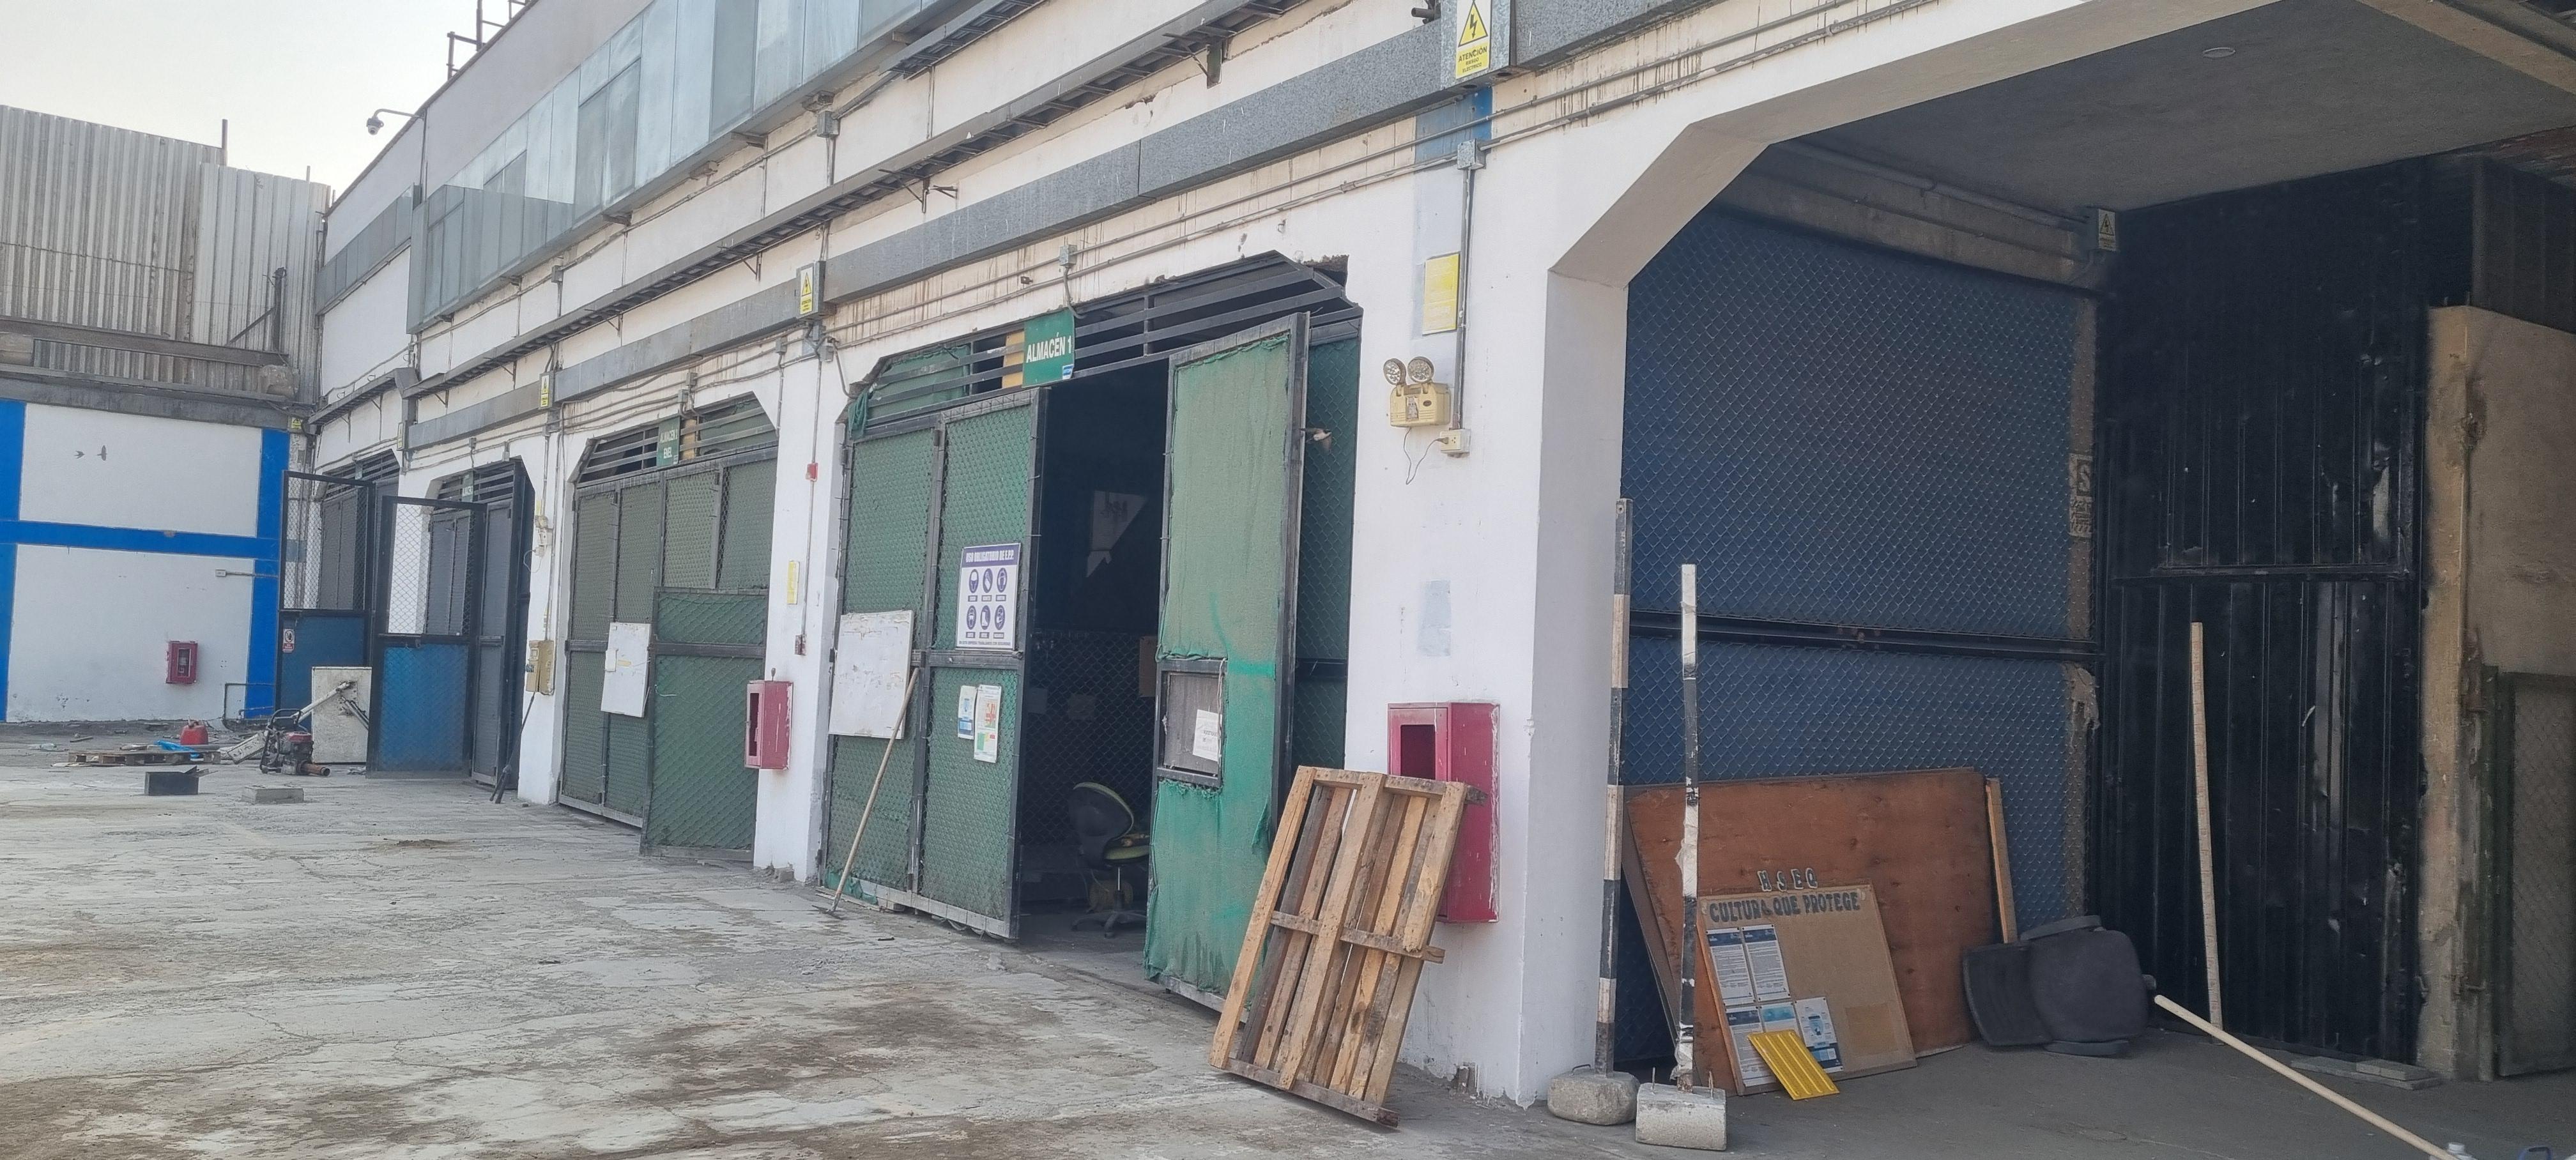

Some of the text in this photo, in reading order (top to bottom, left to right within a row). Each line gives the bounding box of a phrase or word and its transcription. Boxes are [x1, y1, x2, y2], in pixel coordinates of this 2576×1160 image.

[1026, 332, 1071, 363] ALMACÉN 1
[965, 552, 974, 563] USO
[999, 550, 1005, 561] DE
[1710, 892, 1860, 923] CULTURA QUE PROTEGE
